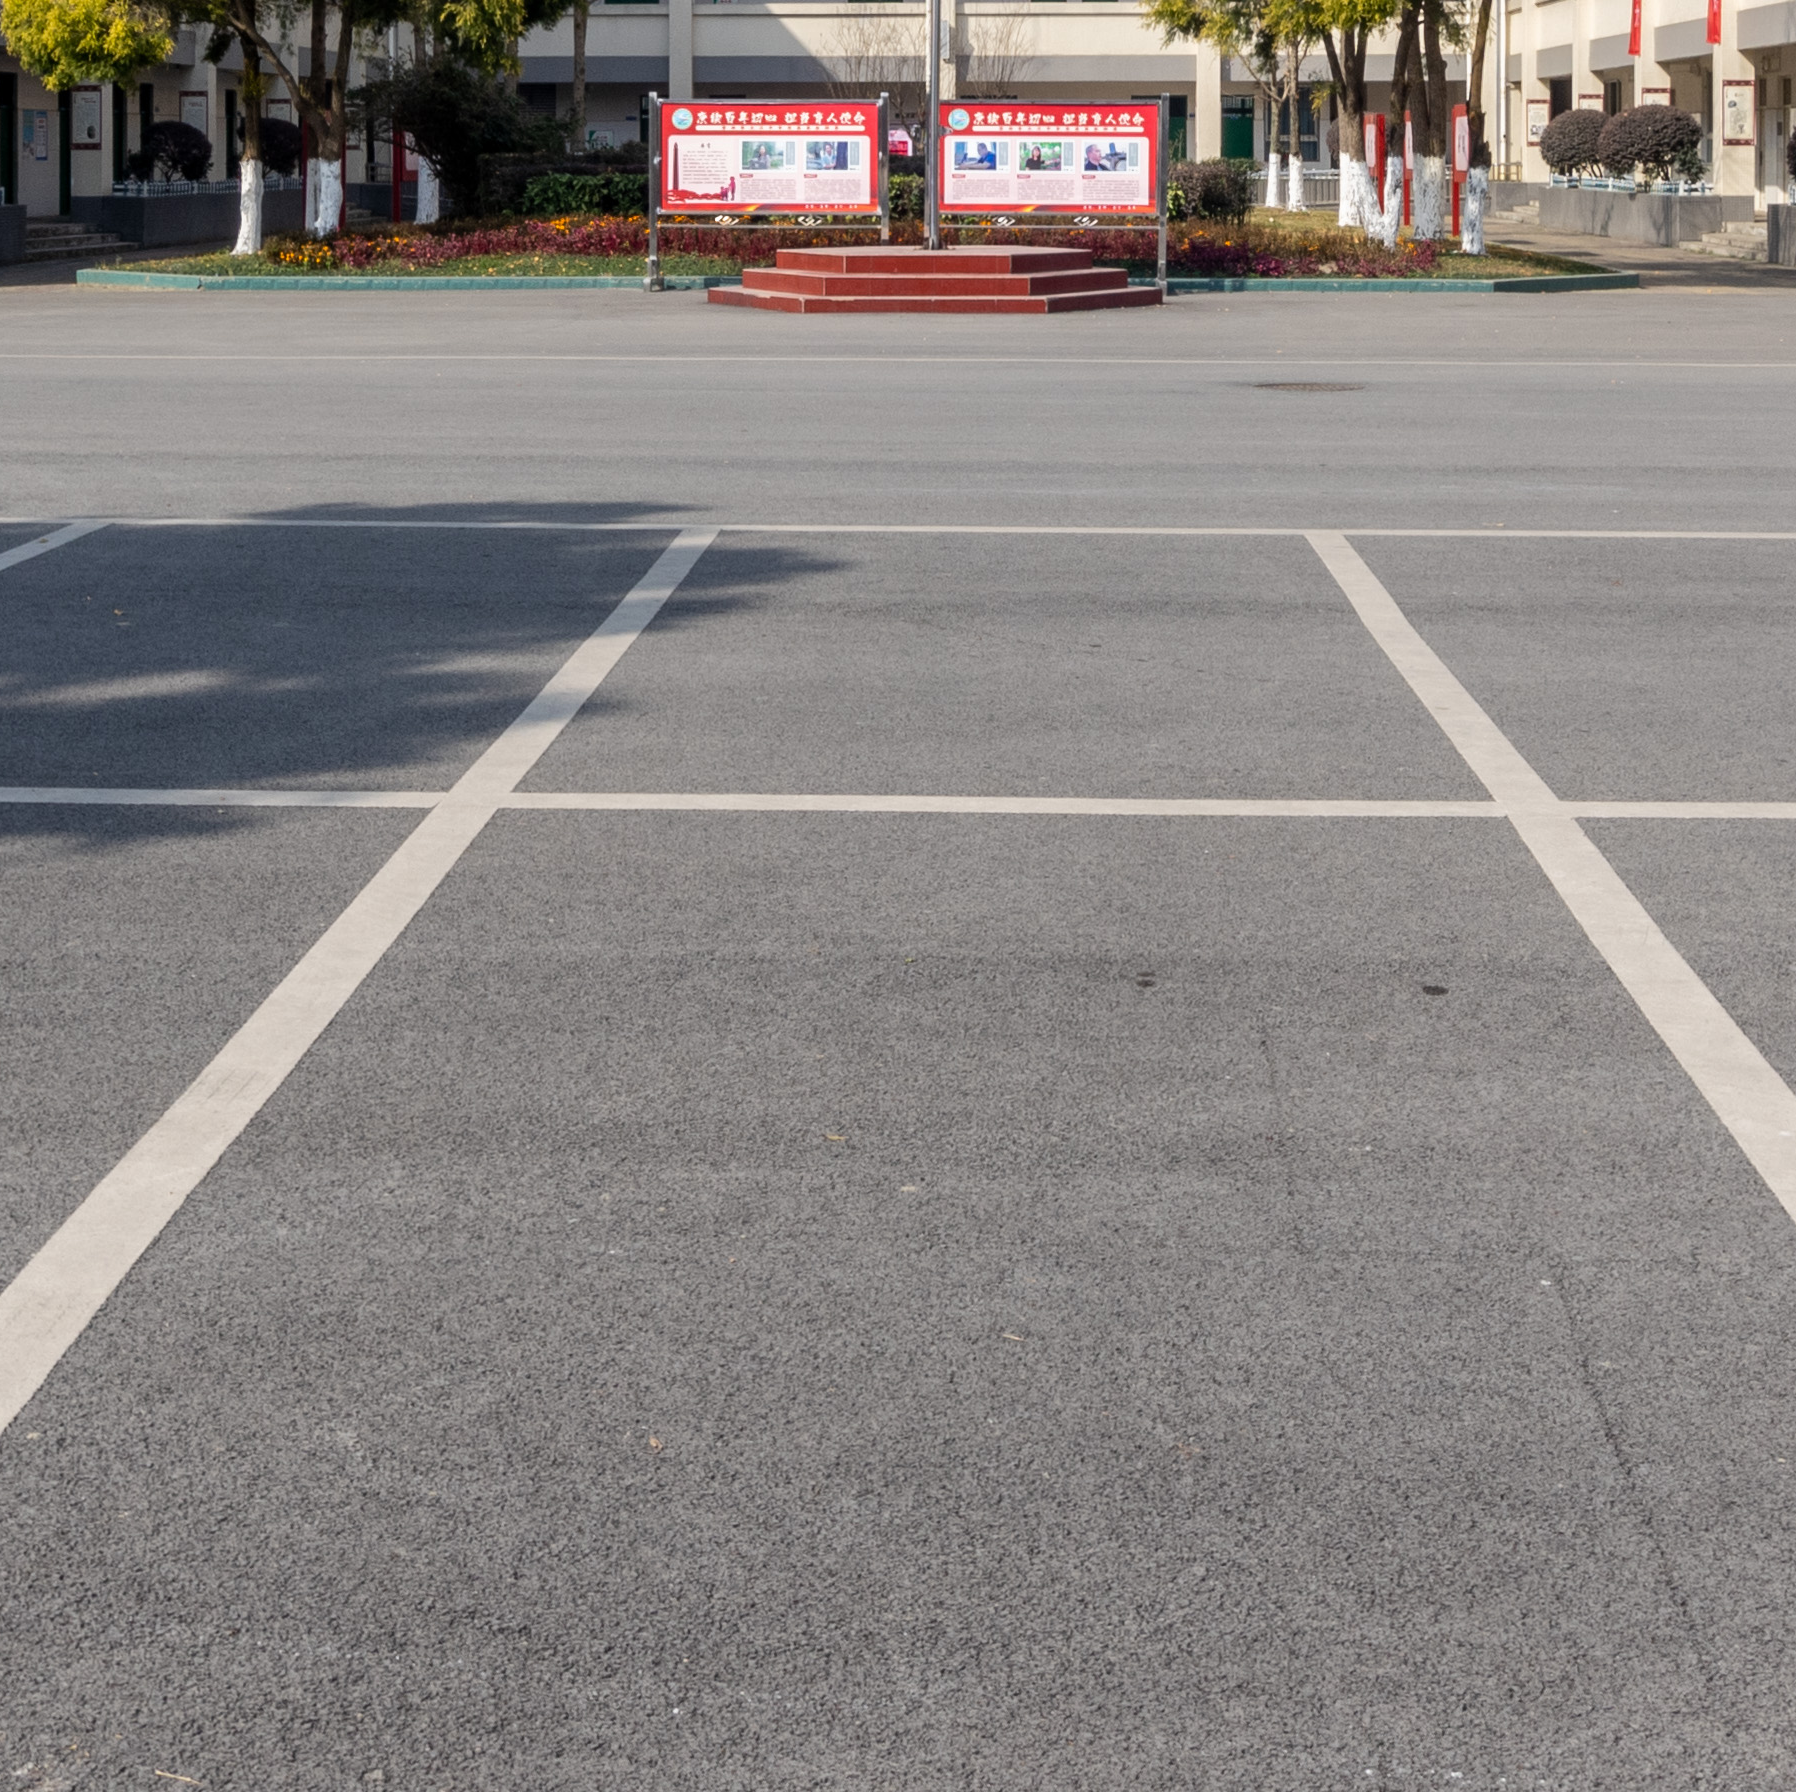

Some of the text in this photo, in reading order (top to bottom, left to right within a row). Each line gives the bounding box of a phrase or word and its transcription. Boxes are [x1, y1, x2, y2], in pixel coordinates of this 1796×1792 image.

[784, 111, 866, 125] 担当育人使命
[1062, 112, 1145, 126] 担当育人使命
